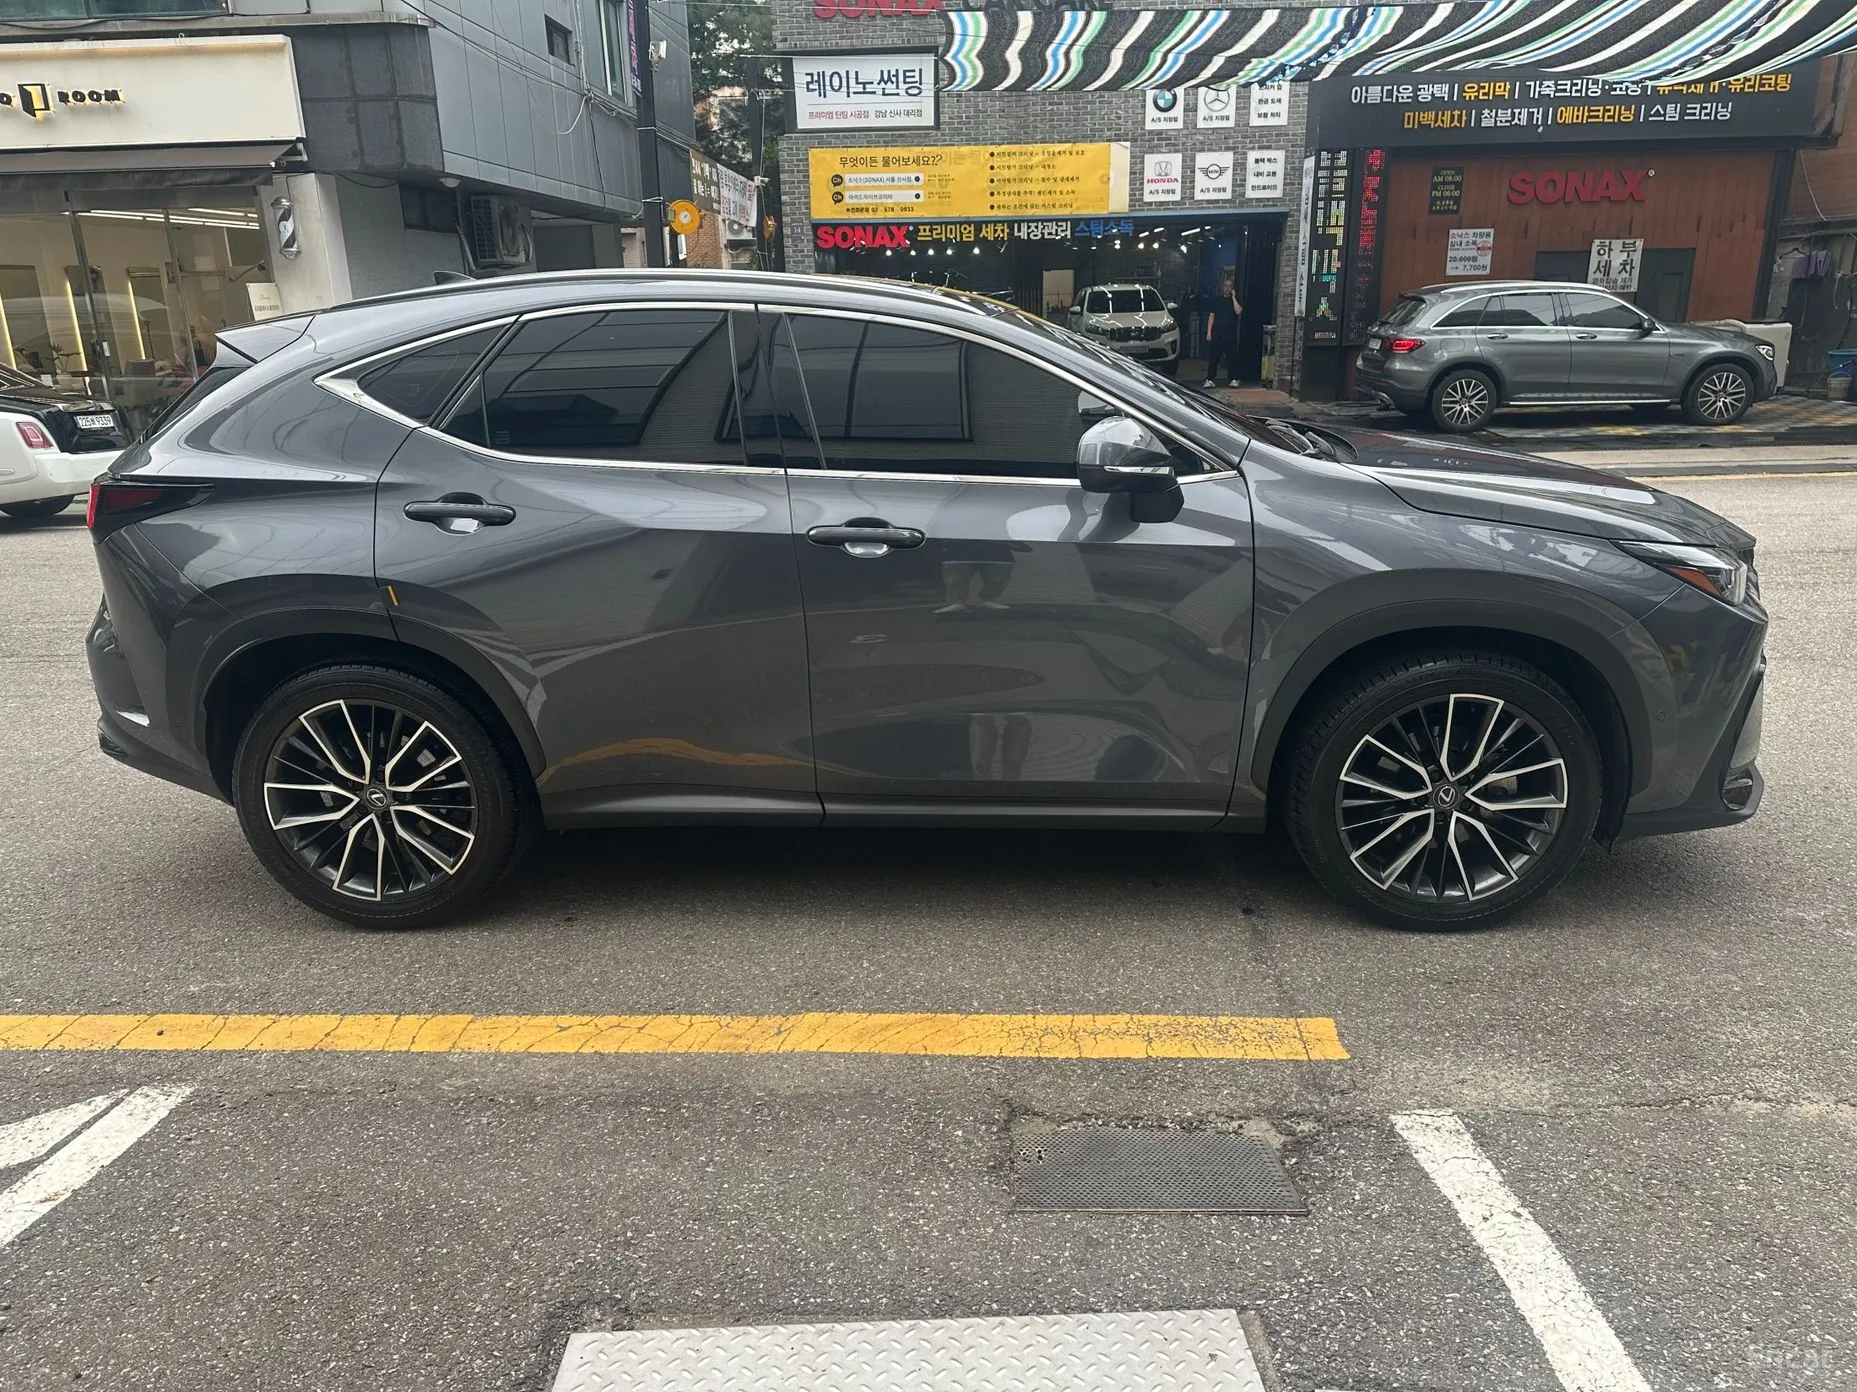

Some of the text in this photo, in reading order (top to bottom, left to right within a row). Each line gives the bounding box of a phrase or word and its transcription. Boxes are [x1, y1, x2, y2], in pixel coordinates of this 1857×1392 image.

[804, 68, 923, 99] 레이노썬팅
[1351, 84, 1413, 104] 아름다운
[1417, 83, 1450, 102] 광택
[1463, 81, 1511, 101] 유리막
[57, 90, 121, 103] ROOM
[808, 110, 834, 120] 프리미엄
[849, 109, 870, 119] 시공점
[874, 109, 887, 119] 강남
[888, 108, 902, 118] 신사
[903, 108, 923, 118] 대리점
[1404, 102, 1732, 129] 미백세차 철분제거 에바크리닝 스팀 크리닝
[839, 154, 943, 168] 무엇이든 물어보세요??
[1507, 170, 1647, 206] SONAX
[816, 218, 1135, 249] SONAX 프리미엄 세차 내장관리 스팀소독
[1450, 231, 1470, 239] 소낙스
[1462, 263, 1489, 272] 7,700원
